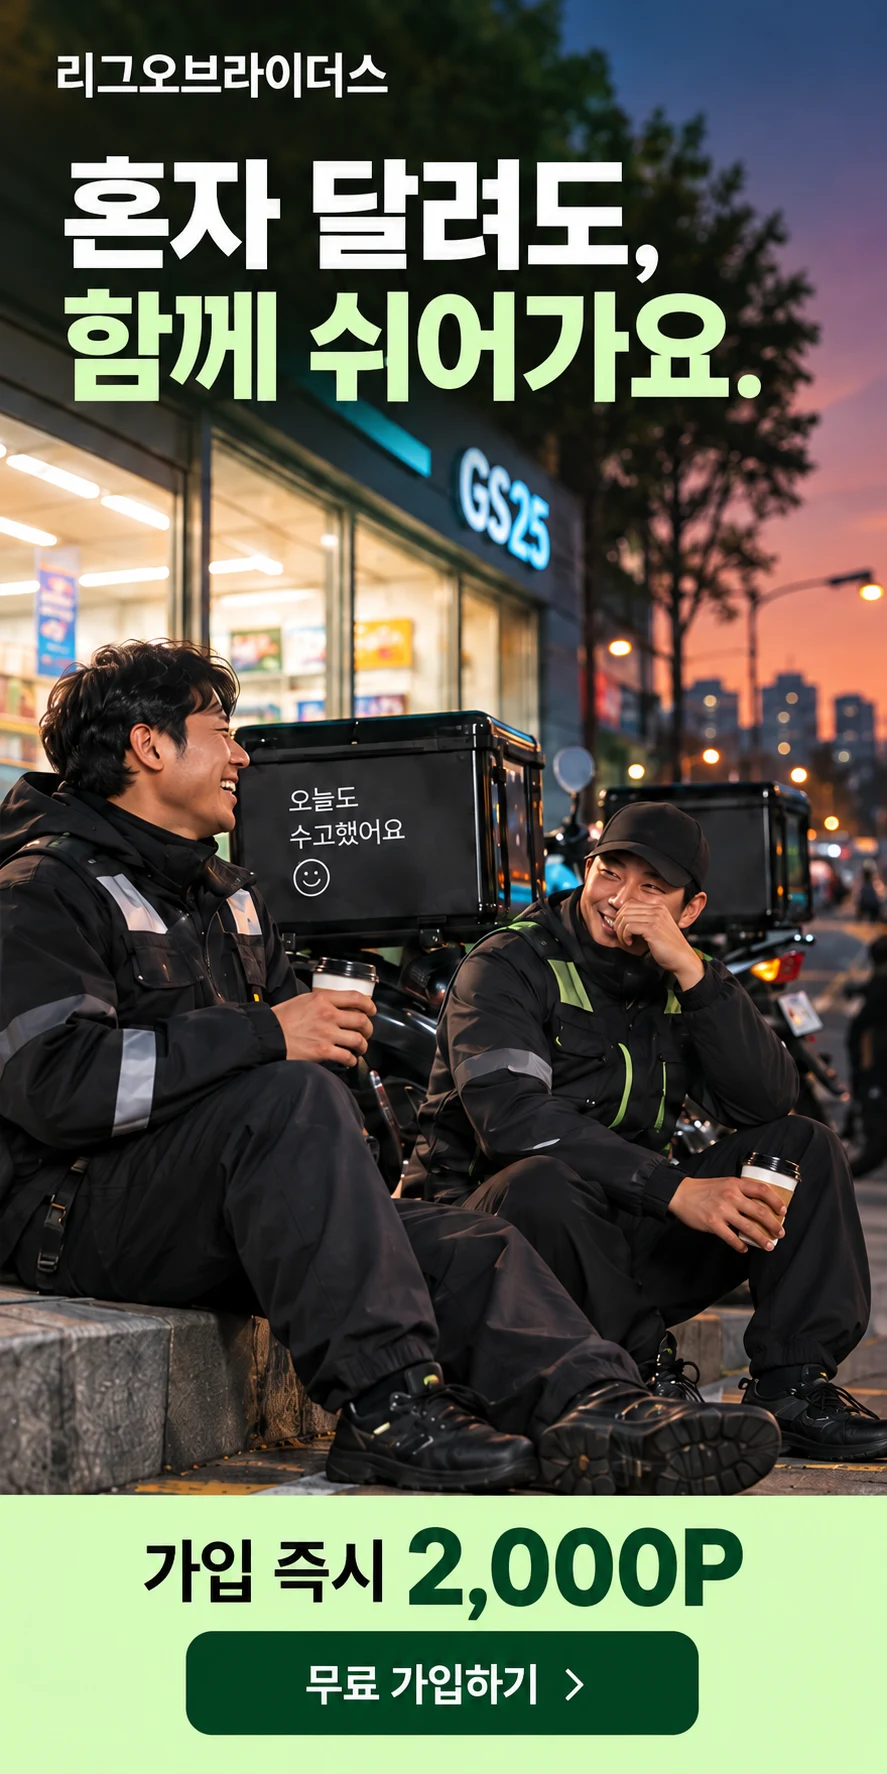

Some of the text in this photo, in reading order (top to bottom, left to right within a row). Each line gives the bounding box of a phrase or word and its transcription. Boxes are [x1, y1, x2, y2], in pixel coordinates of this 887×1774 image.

[459, 447, 550, 571] GS25
[288, 786, 359, 812] 오늘도
[289, 818, 406, 849] 수고했어요
